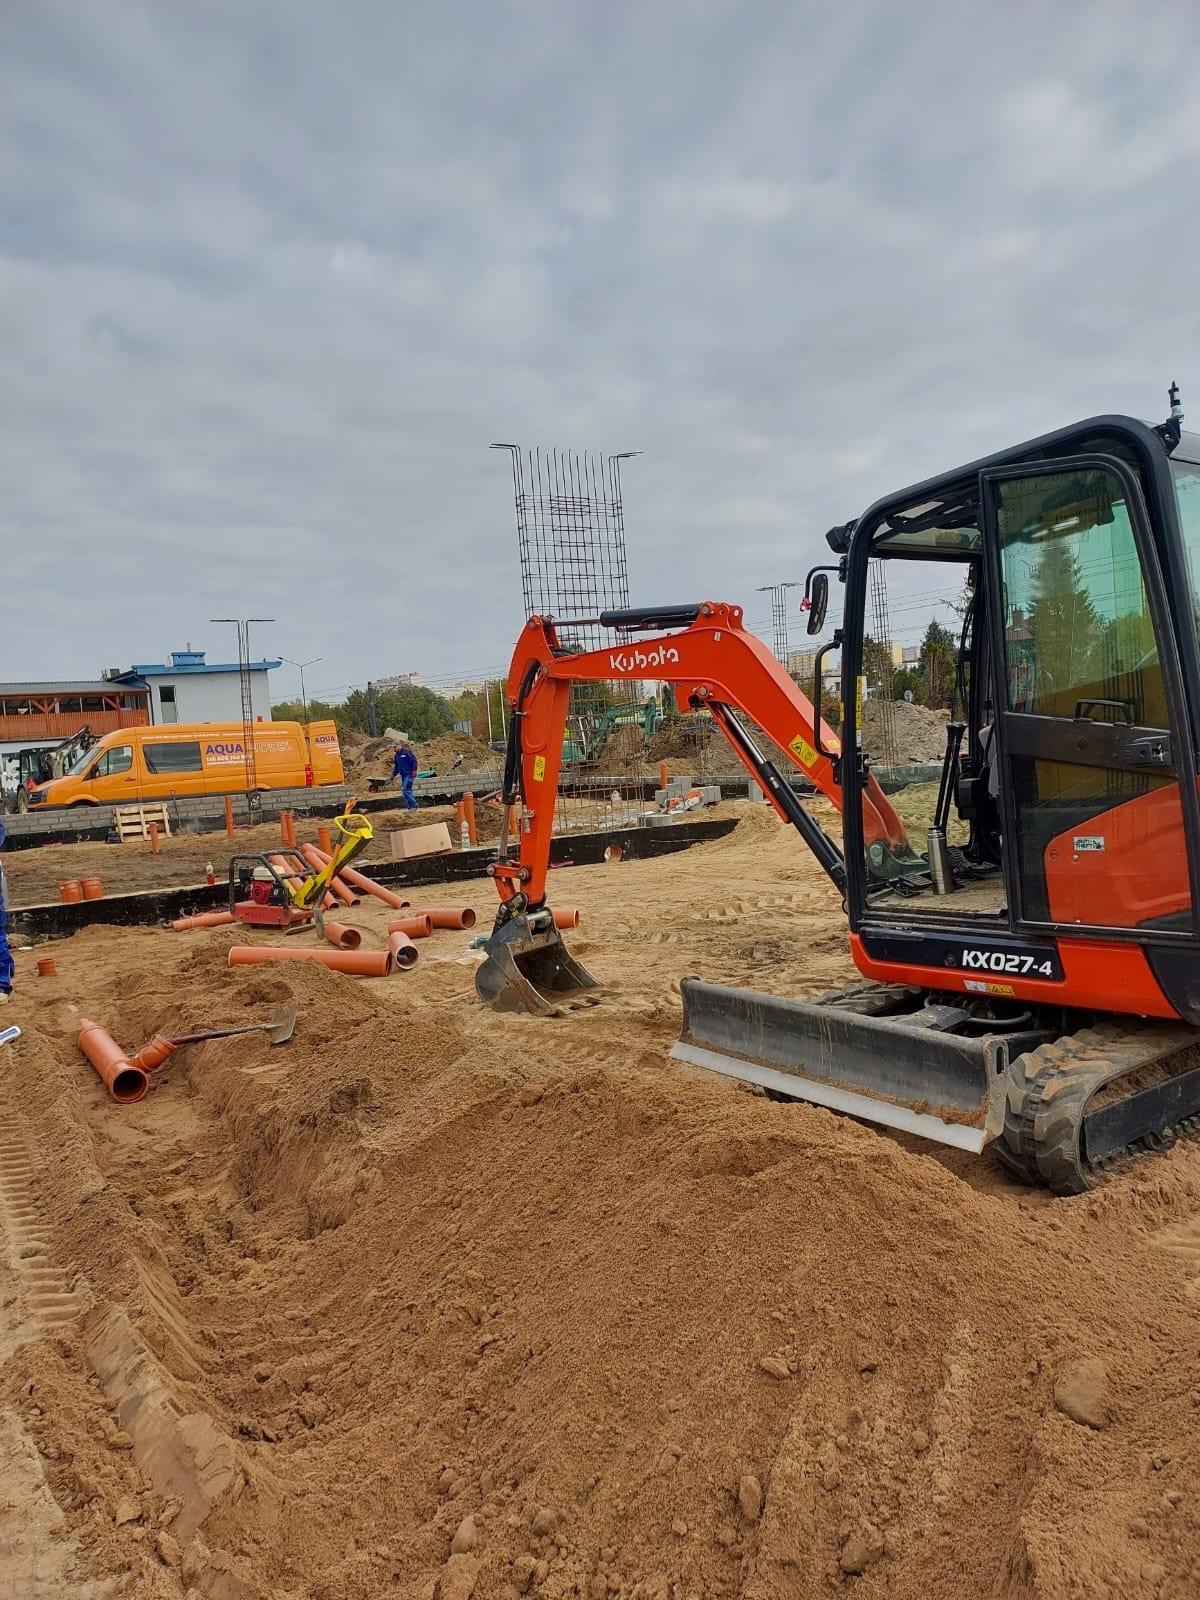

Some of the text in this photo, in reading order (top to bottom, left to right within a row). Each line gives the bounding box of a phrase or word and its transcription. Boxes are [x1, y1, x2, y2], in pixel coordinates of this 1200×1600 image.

[609, 645, 680, 672] Kubota
[206, 743, 244, 756] AQUA
[315, 735, 336, 745] AQUA
[962, 949, 1053, 976] KX027-4
